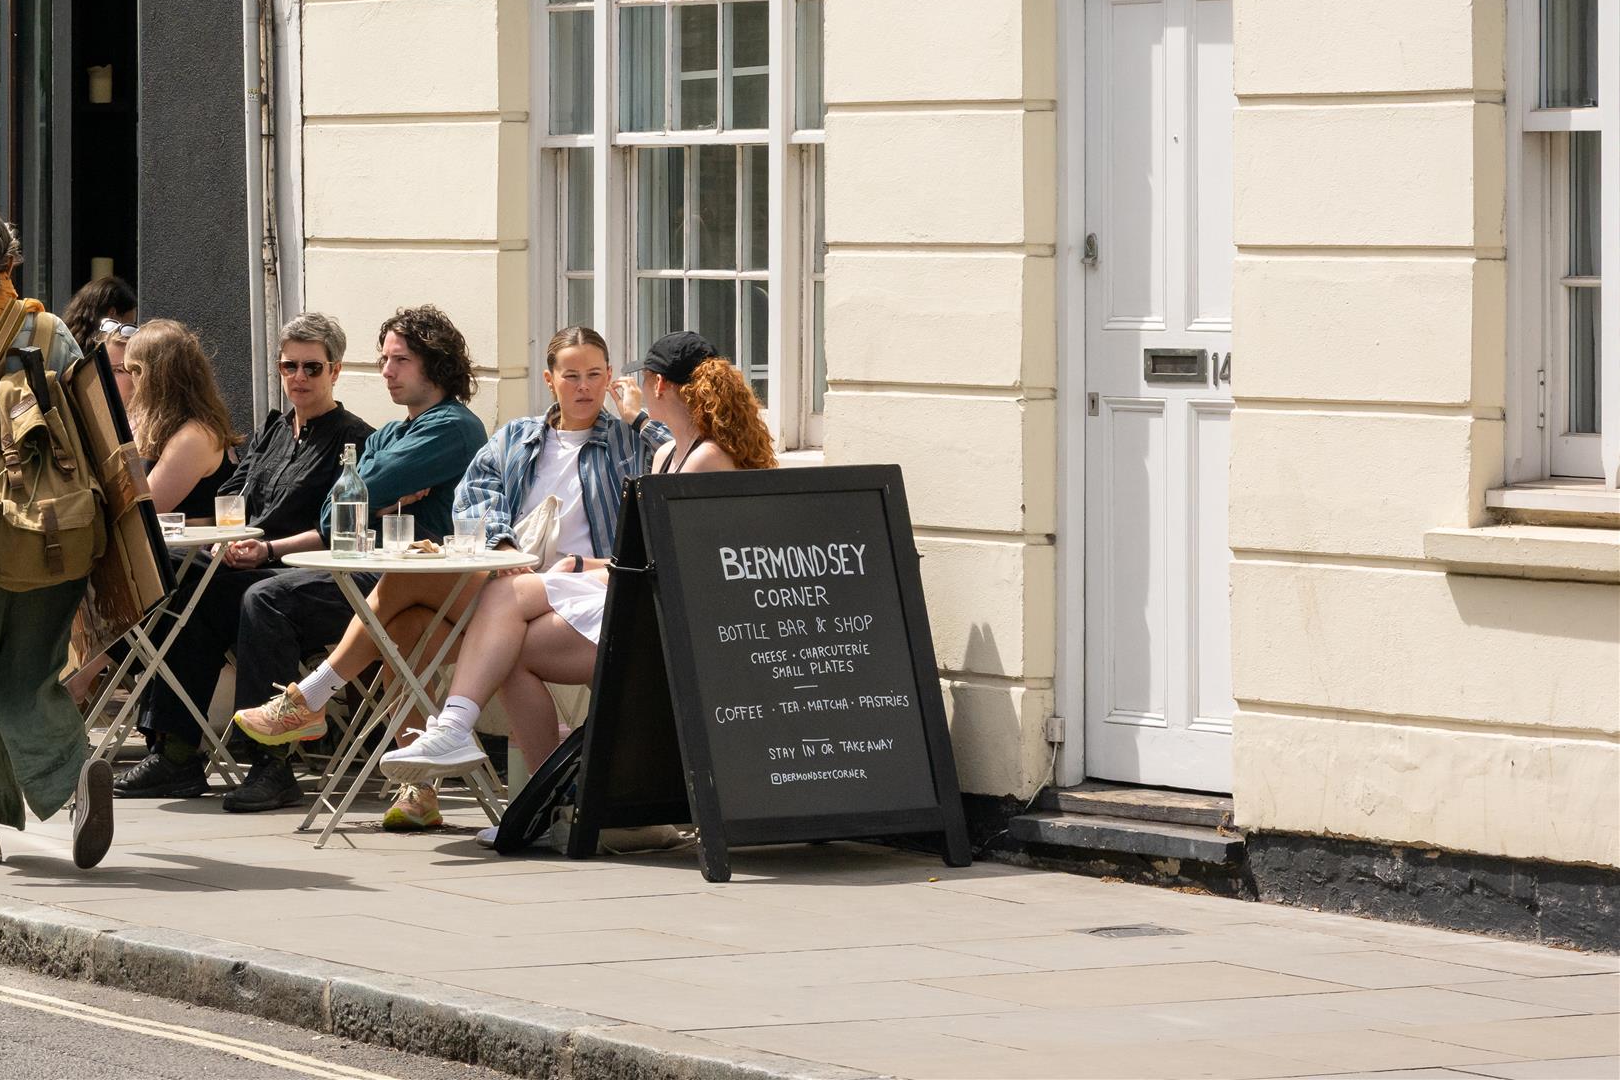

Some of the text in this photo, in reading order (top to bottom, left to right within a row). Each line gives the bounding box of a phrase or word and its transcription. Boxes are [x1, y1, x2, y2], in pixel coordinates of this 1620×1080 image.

[719, 543, 866, 581] BERMONDSEY
[754, 585, 830, 609] CORNER
[717, 614, 873, 643] BOTTLE BAR & SHOP
[750, 649, 788, 664] CHEESE
[771, 660, 855, 680] SMALL PLATES
[715, 704, 764, 724] COFFEE
[778, 700, 800, 714] TEA
[806, 697, 850, 713] MATCHA
[768, 738, 894, 760] STAY IN OR TAKEAWAY
